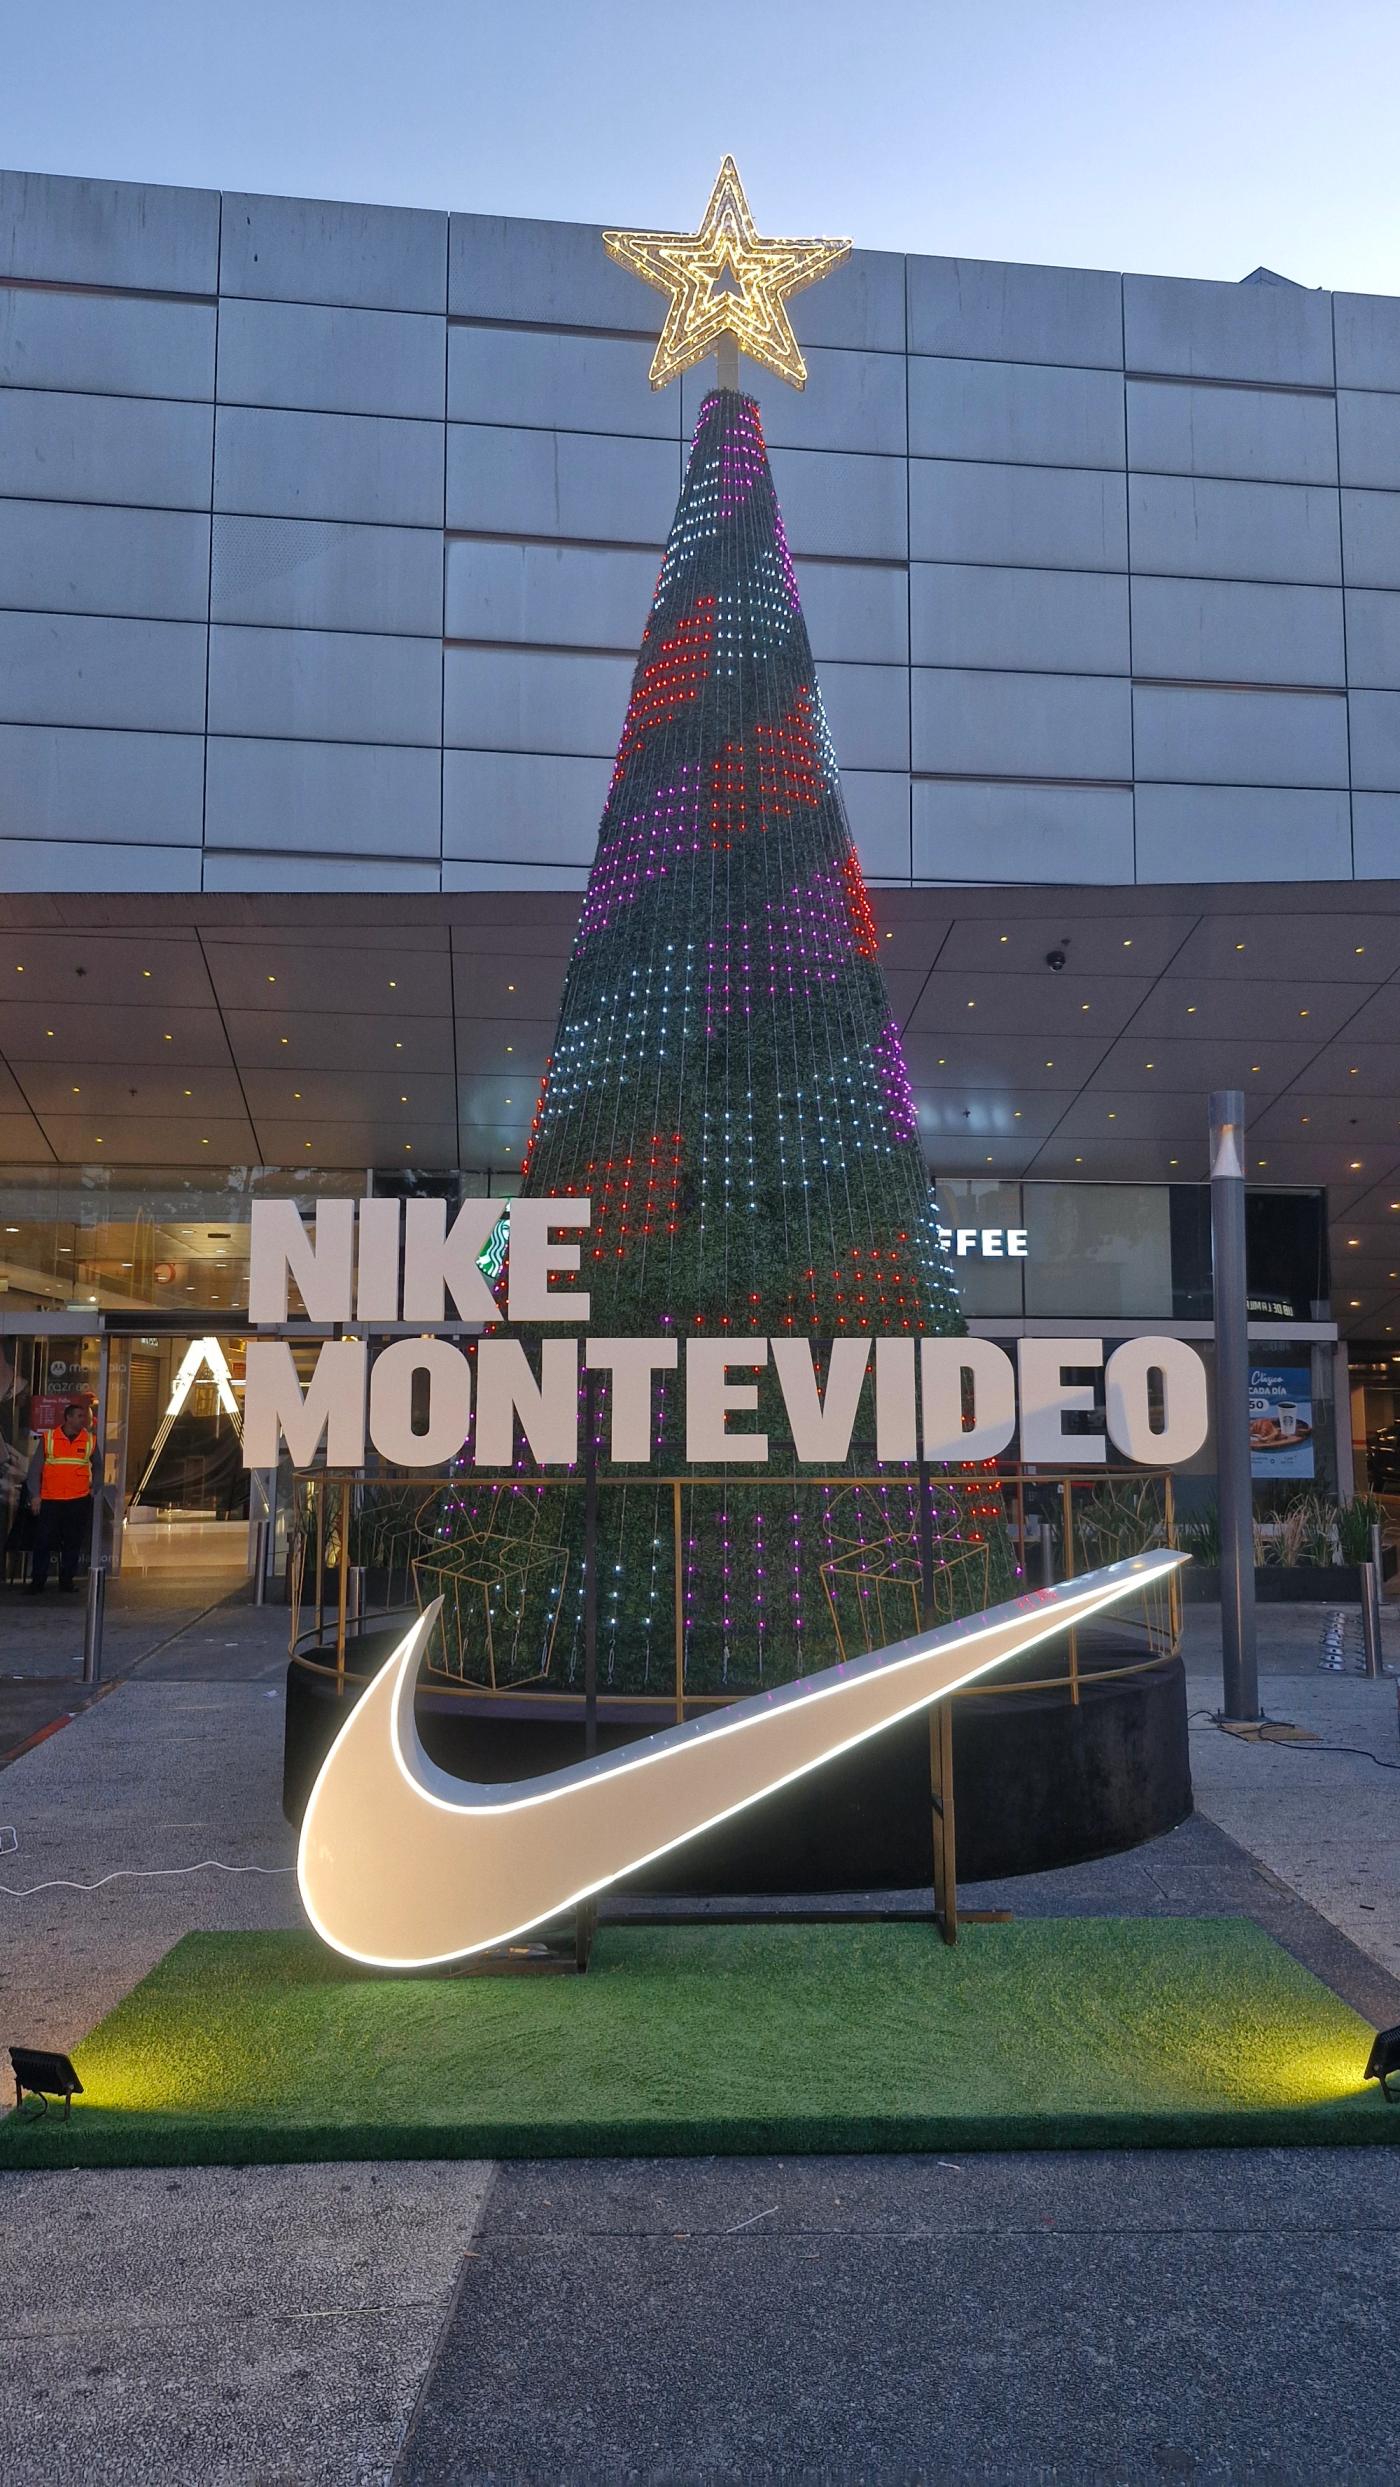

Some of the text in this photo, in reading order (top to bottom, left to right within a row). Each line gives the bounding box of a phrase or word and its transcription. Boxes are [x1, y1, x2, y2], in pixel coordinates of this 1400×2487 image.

[248, 1197, 592, 1323] NIKE
[242, 1335, 1209, 1469] MONTEVIDEO
[1271, 1385, 1287, 1395] DÍA
